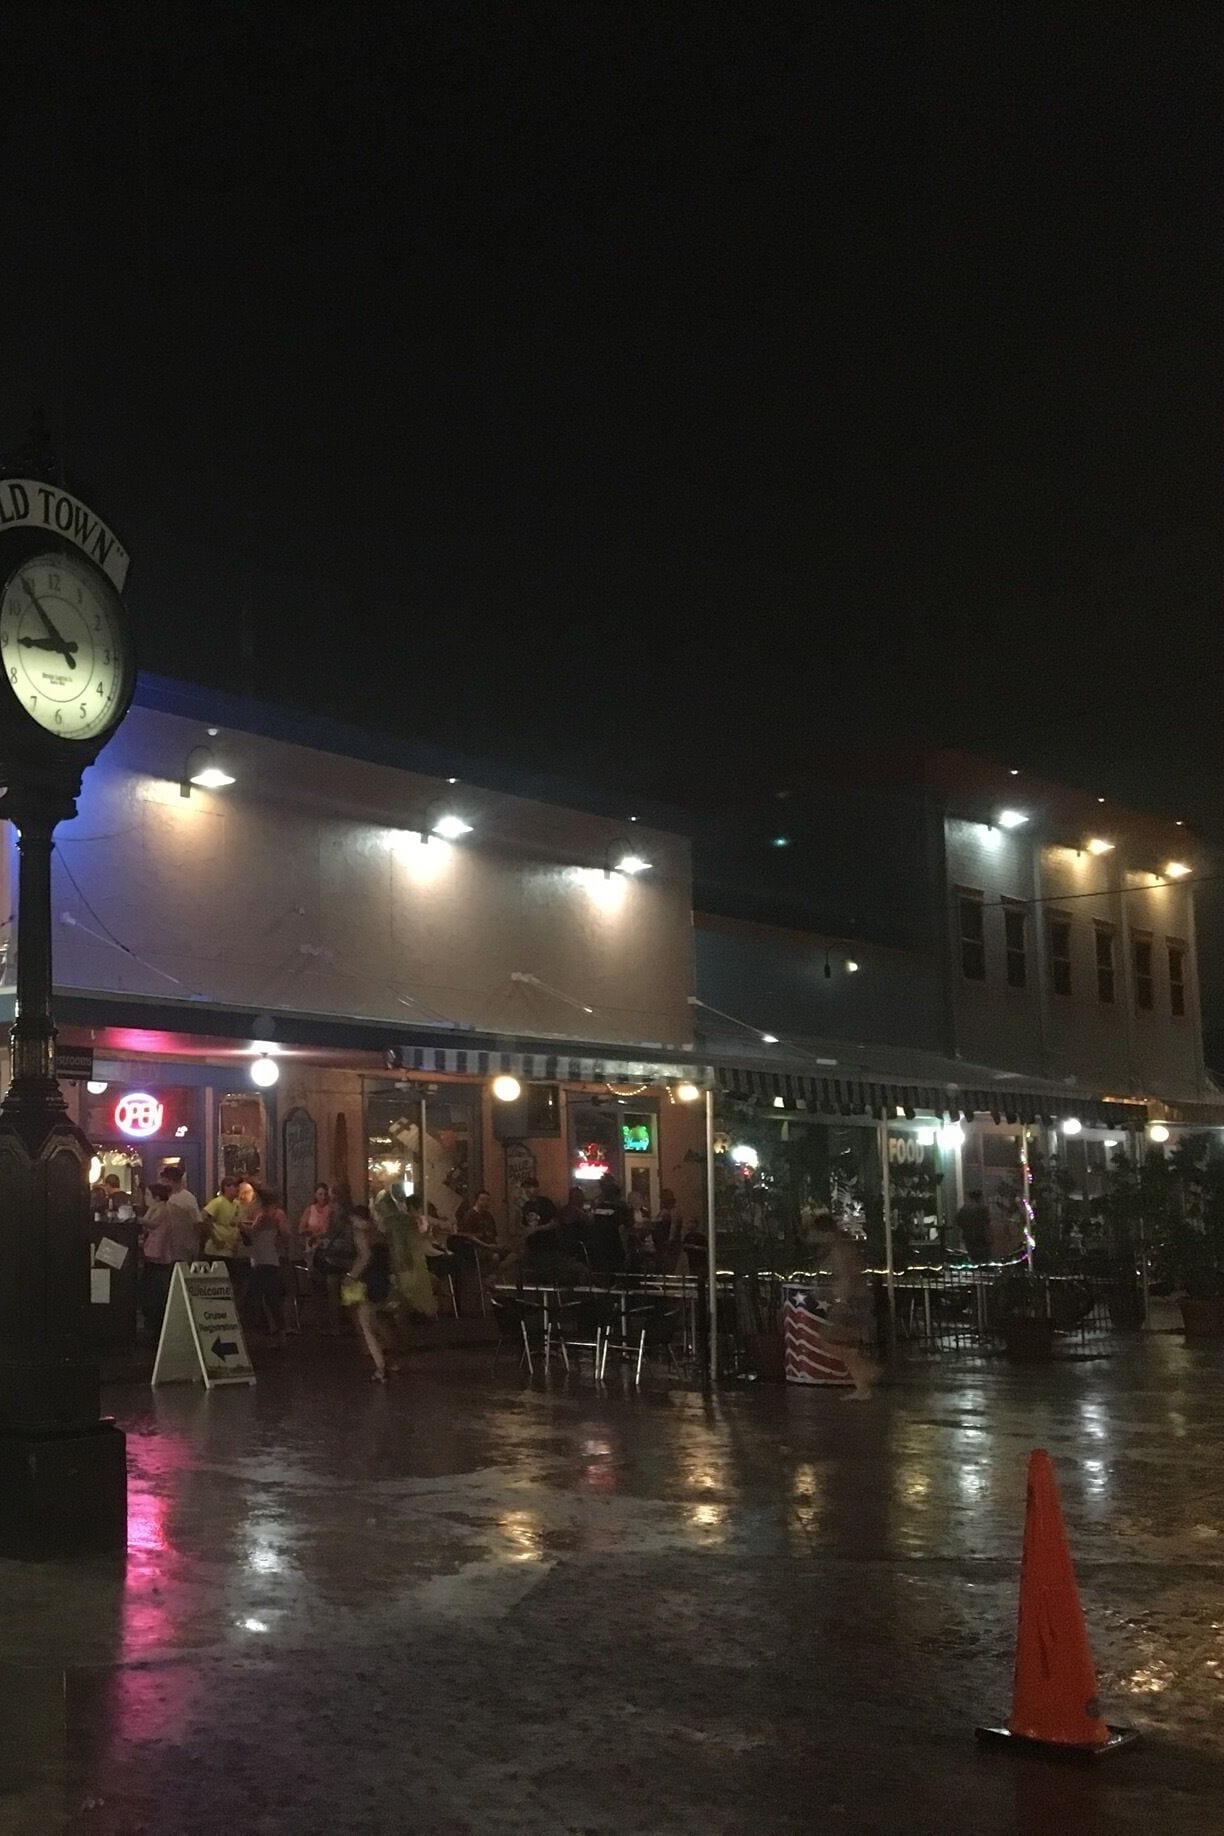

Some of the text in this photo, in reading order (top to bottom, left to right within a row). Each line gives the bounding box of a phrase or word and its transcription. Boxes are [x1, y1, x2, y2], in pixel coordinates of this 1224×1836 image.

[103, 649, 111, 666] 3
[10, 667, 18, 684] 8
[96, 681, 104, 697] 4
[30, 696, 38, 713] 7
[79, 703, 88, 719] 5
[55, 709, 63, 725] 6
[115, 1098, 164, 1132] OPEN
